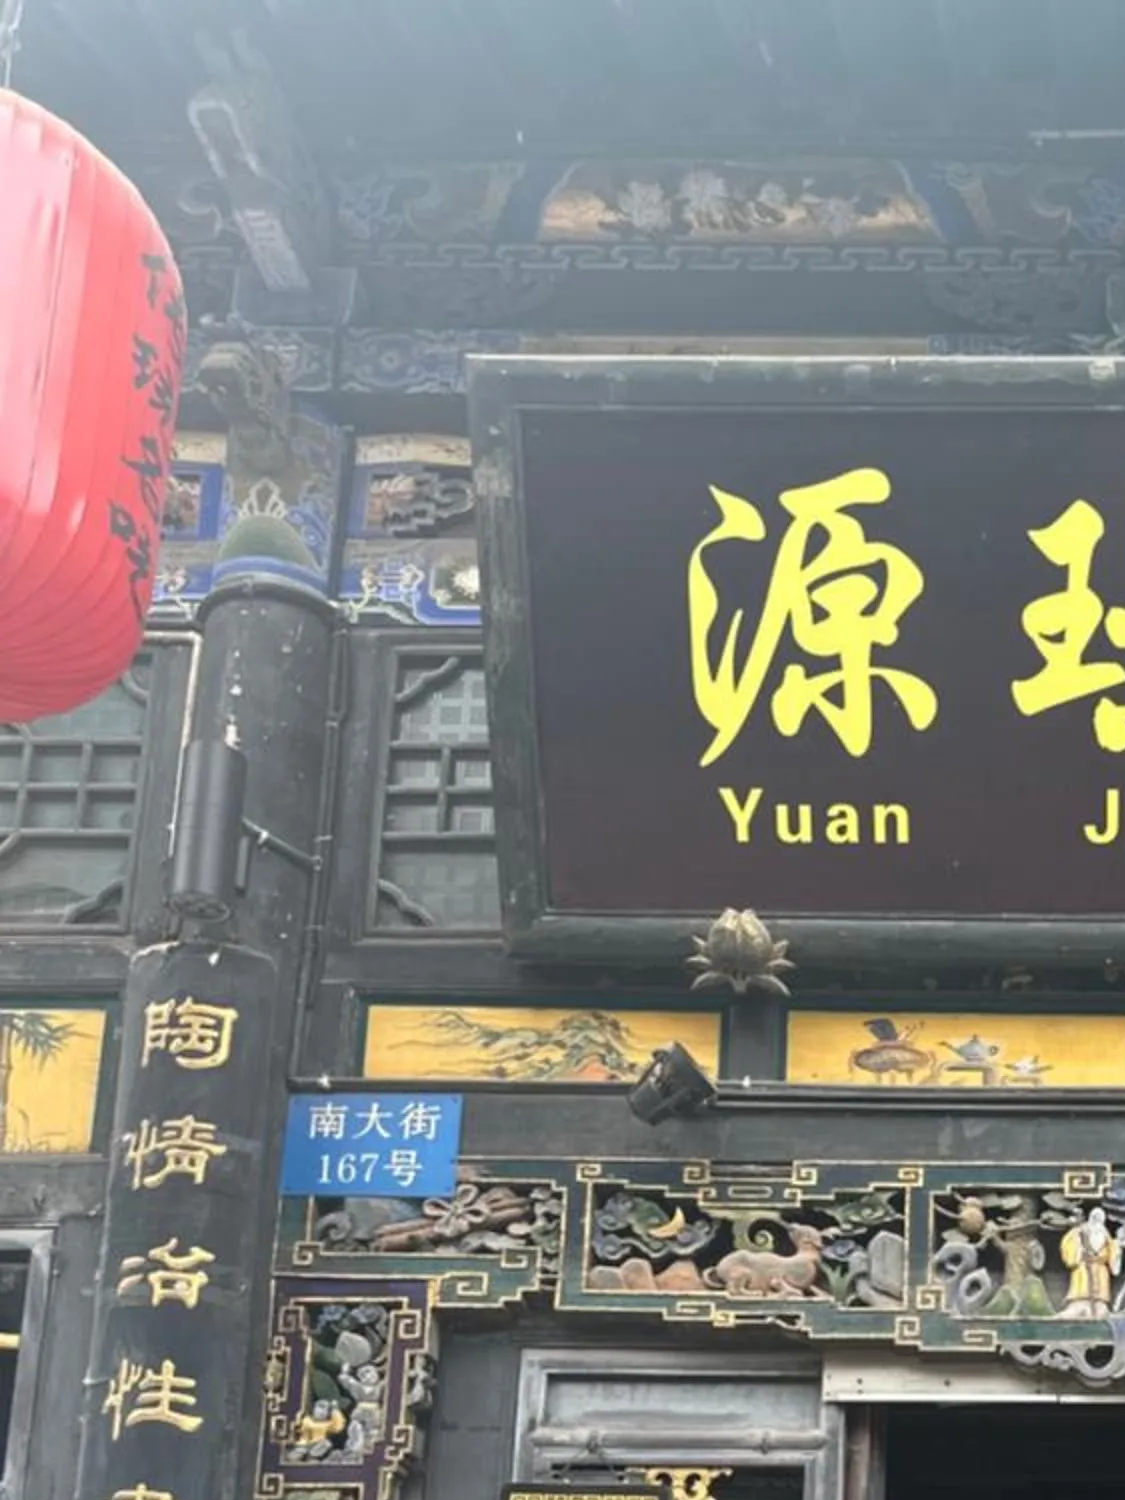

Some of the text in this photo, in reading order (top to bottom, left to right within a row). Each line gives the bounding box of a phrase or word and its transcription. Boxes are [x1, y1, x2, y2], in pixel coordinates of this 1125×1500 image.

[719, 787, 911, 845] Yuan
[309, 1101, 442, 1141] 南大街
[319, 1149, 423, 1187] 167号
